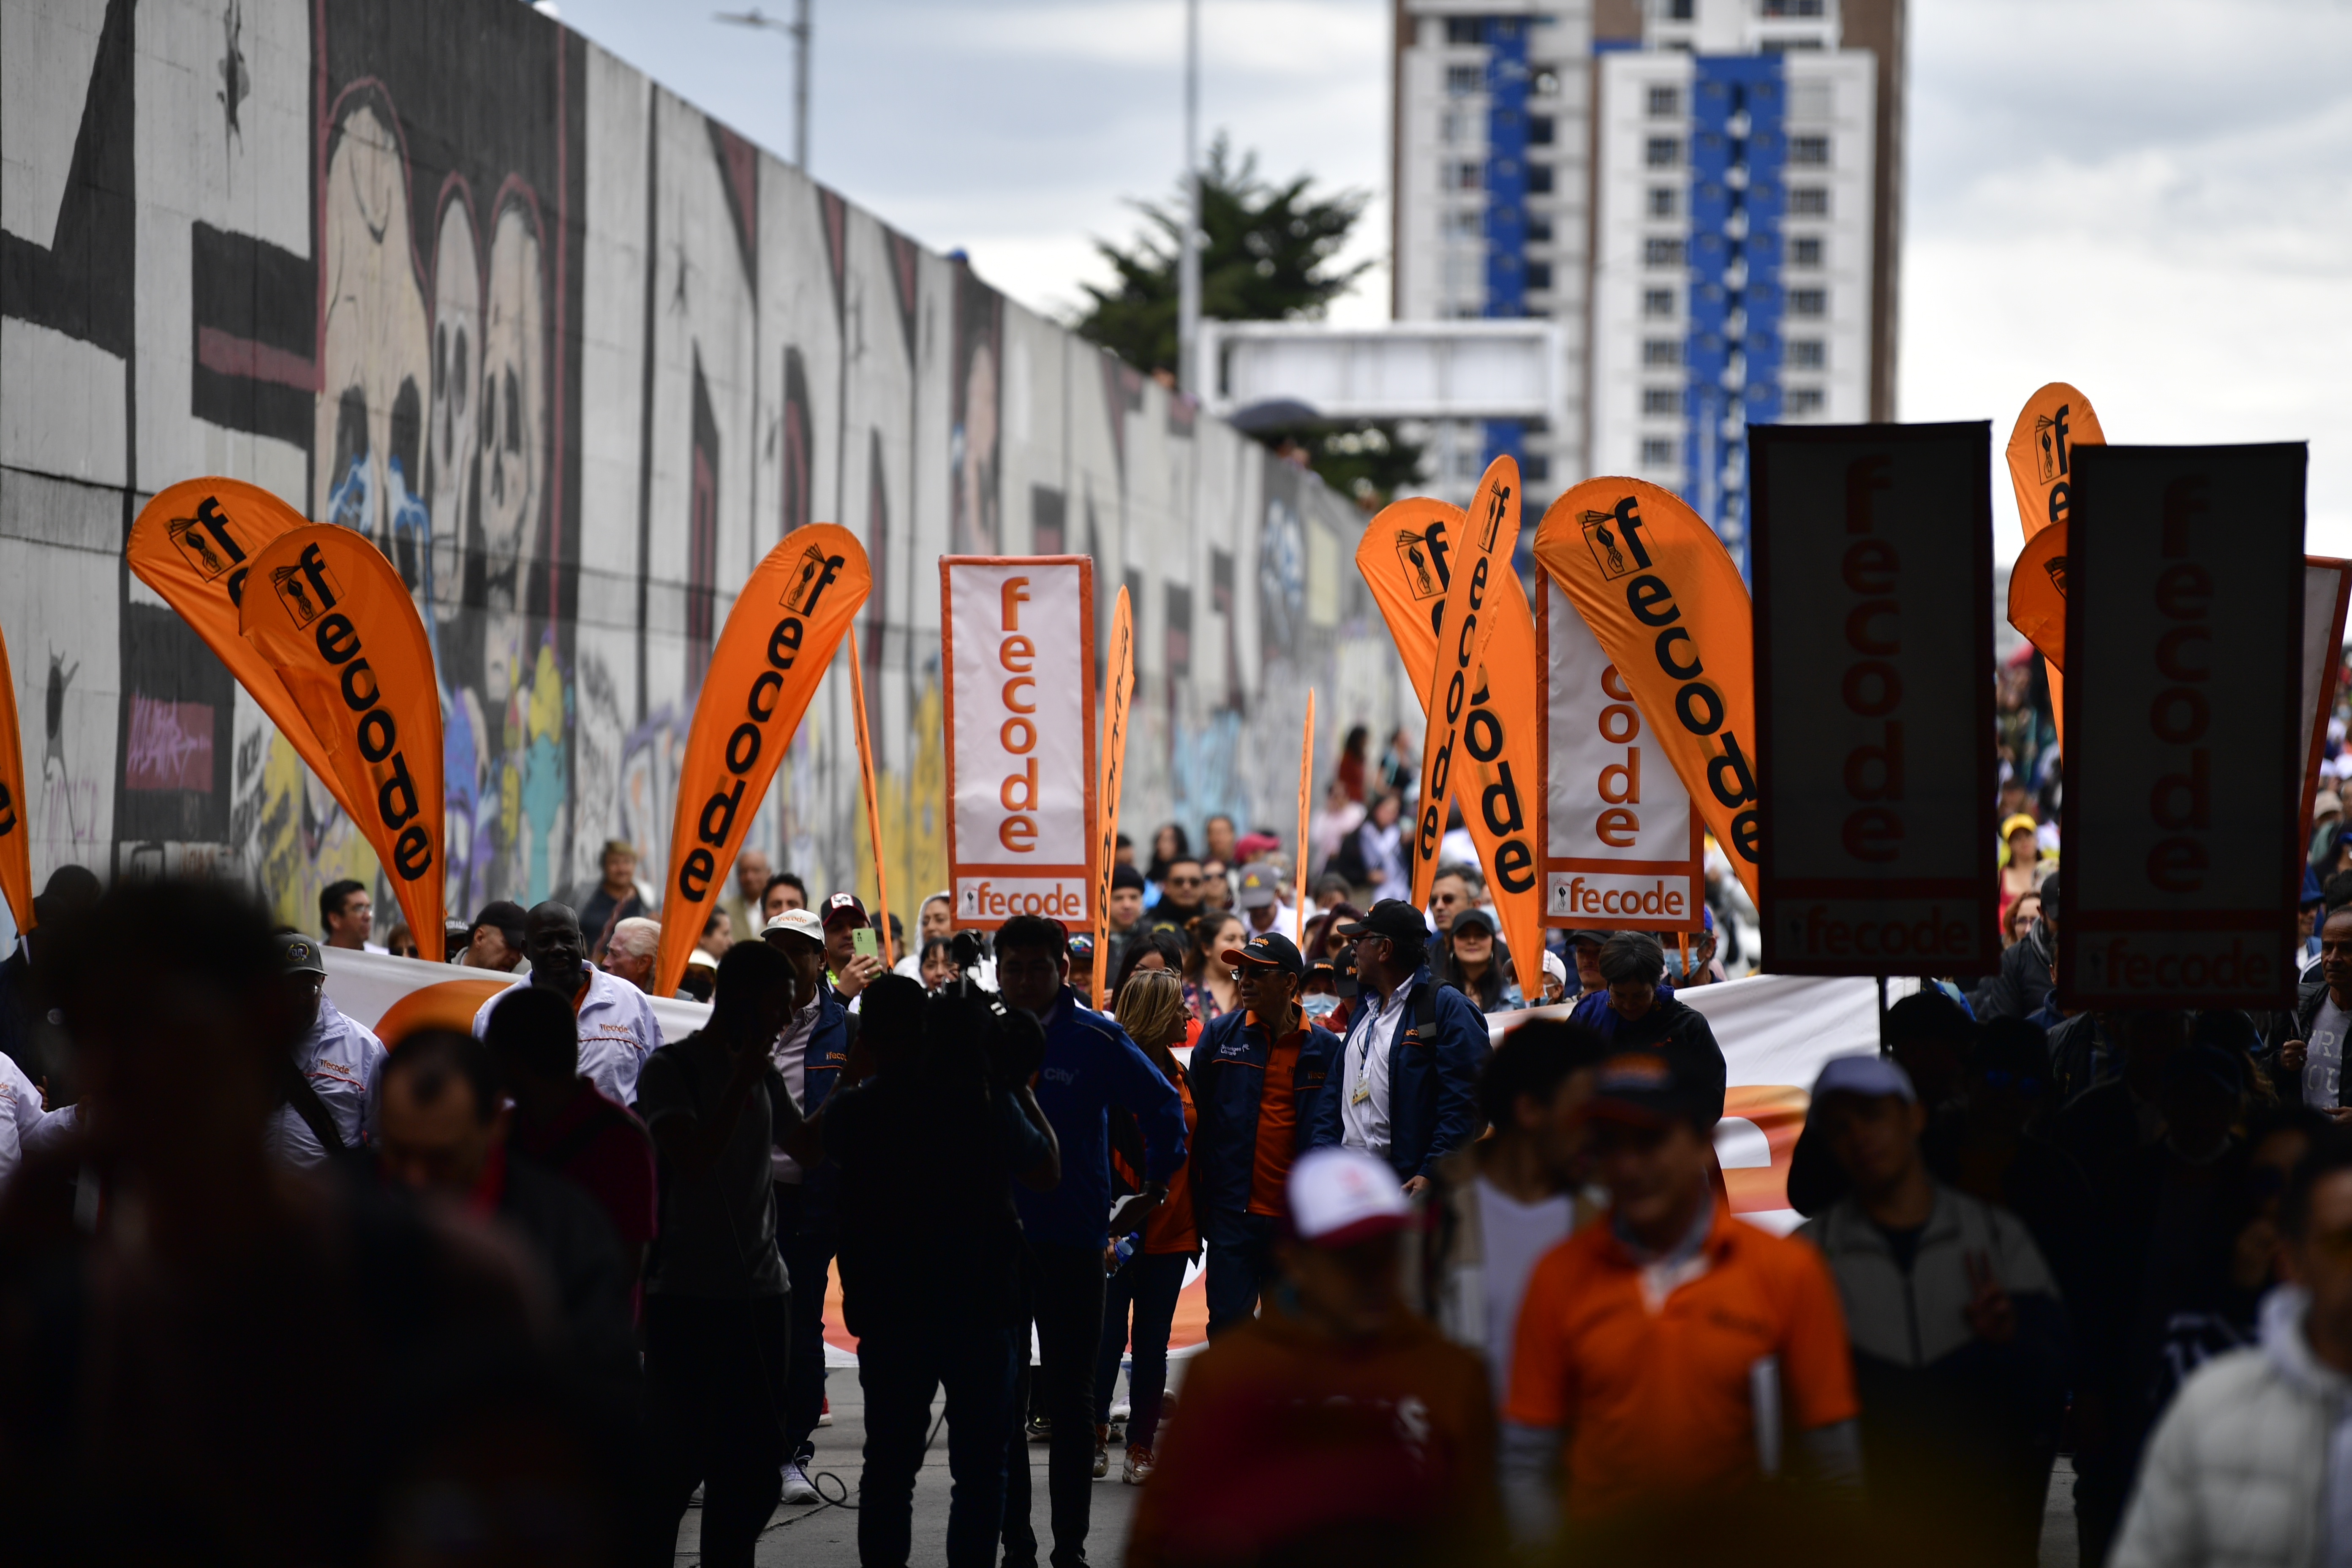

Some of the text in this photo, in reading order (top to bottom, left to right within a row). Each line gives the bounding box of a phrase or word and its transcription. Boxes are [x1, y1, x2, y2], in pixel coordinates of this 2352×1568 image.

[300, 542, 433, 881] fecode
[679, 555, 845, 902] fecode
[999, 577, 1038, 852] fecode
[1420, 486, 1511, 860] fecode
[1425, 521, 1536, 894] fode
[1842, 454, 1906, 862] fecode
[2147, 474, 2214, 893] fecode
[1596, 664, 1640, 847] code
[977, 882, 1081, 916] fecode
[1571, 877, 1685, 915] fecode
[1808, 904, 1971, 956] fecode
[2107, 937, 2271, 989] fecode
[324, 1060, 349, 1074] fecode
[603, 1024, 628, 1033] fecode
[829, 1051, 847, 1062] feco
